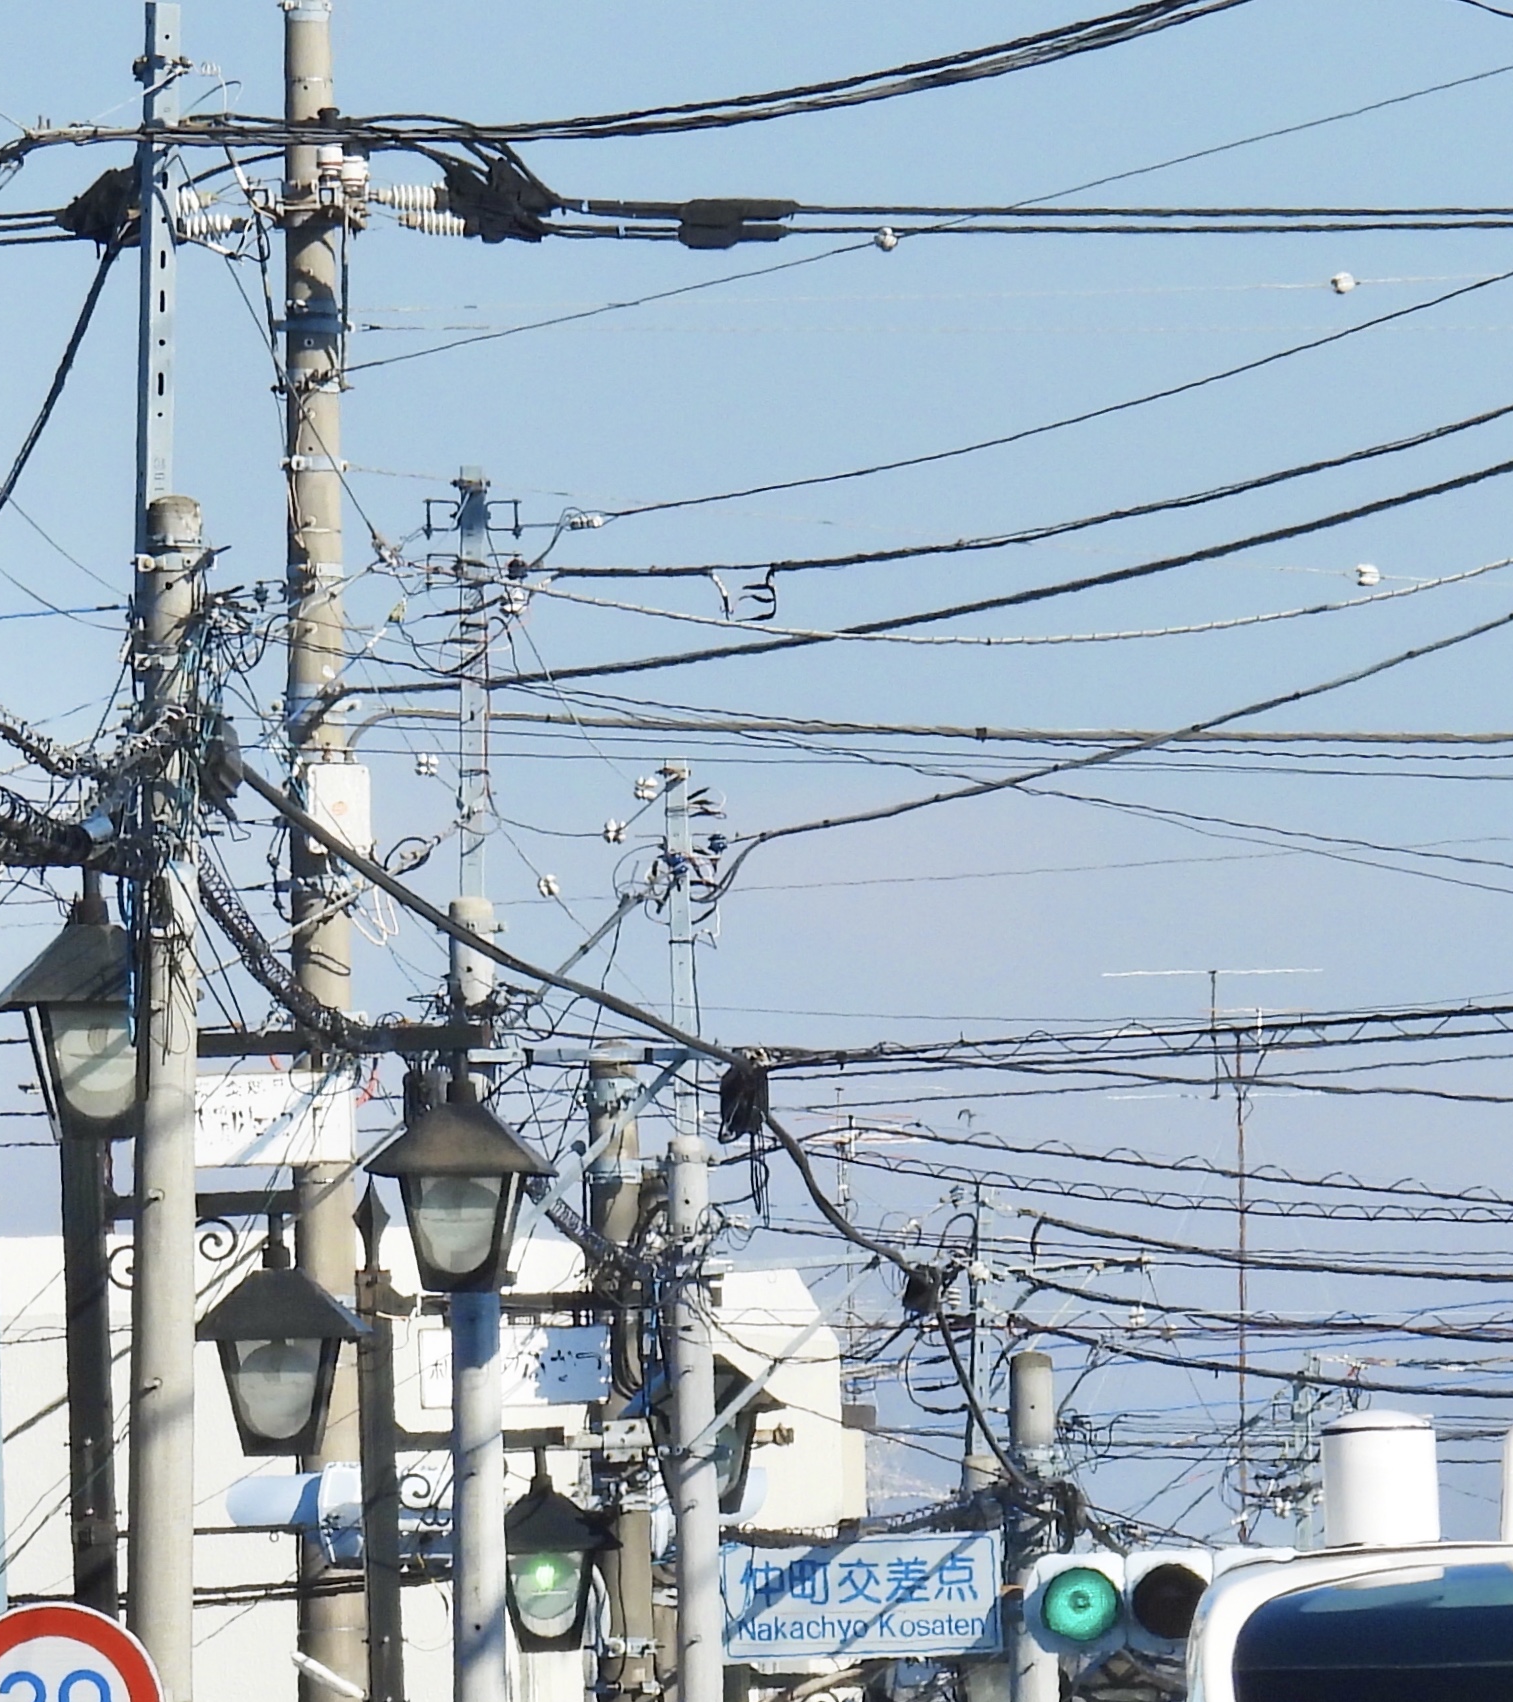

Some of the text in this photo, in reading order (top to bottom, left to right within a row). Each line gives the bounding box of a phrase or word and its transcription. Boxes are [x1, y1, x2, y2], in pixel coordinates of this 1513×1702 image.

[739, 1554, 978, 1607] 仲町交差点
[739, 1613, 986, 1645] Nakachyo Kosaten
